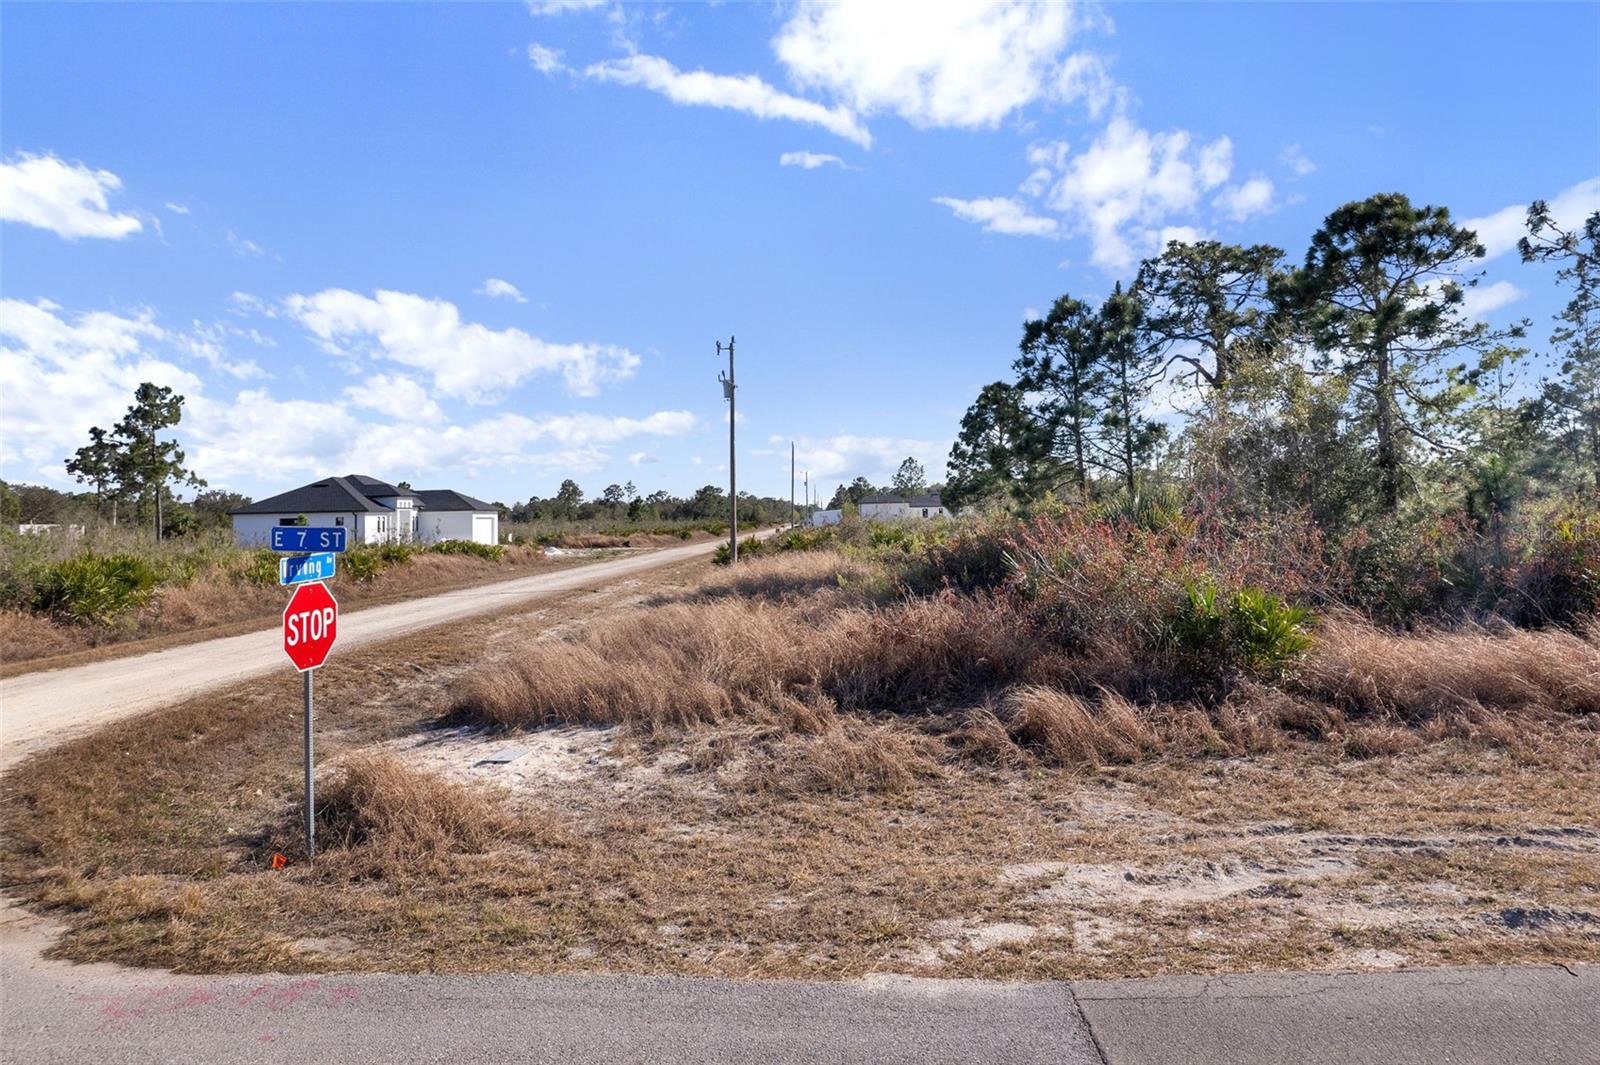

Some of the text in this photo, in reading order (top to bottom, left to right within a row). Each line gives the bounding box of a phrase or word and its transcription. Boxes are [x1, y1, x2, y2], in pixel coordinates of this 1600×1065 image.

[275, 531, 342, 547] E 7 ST
[283, 560, 321, 578] Irving
[287, 607, 334, 646] STOP
